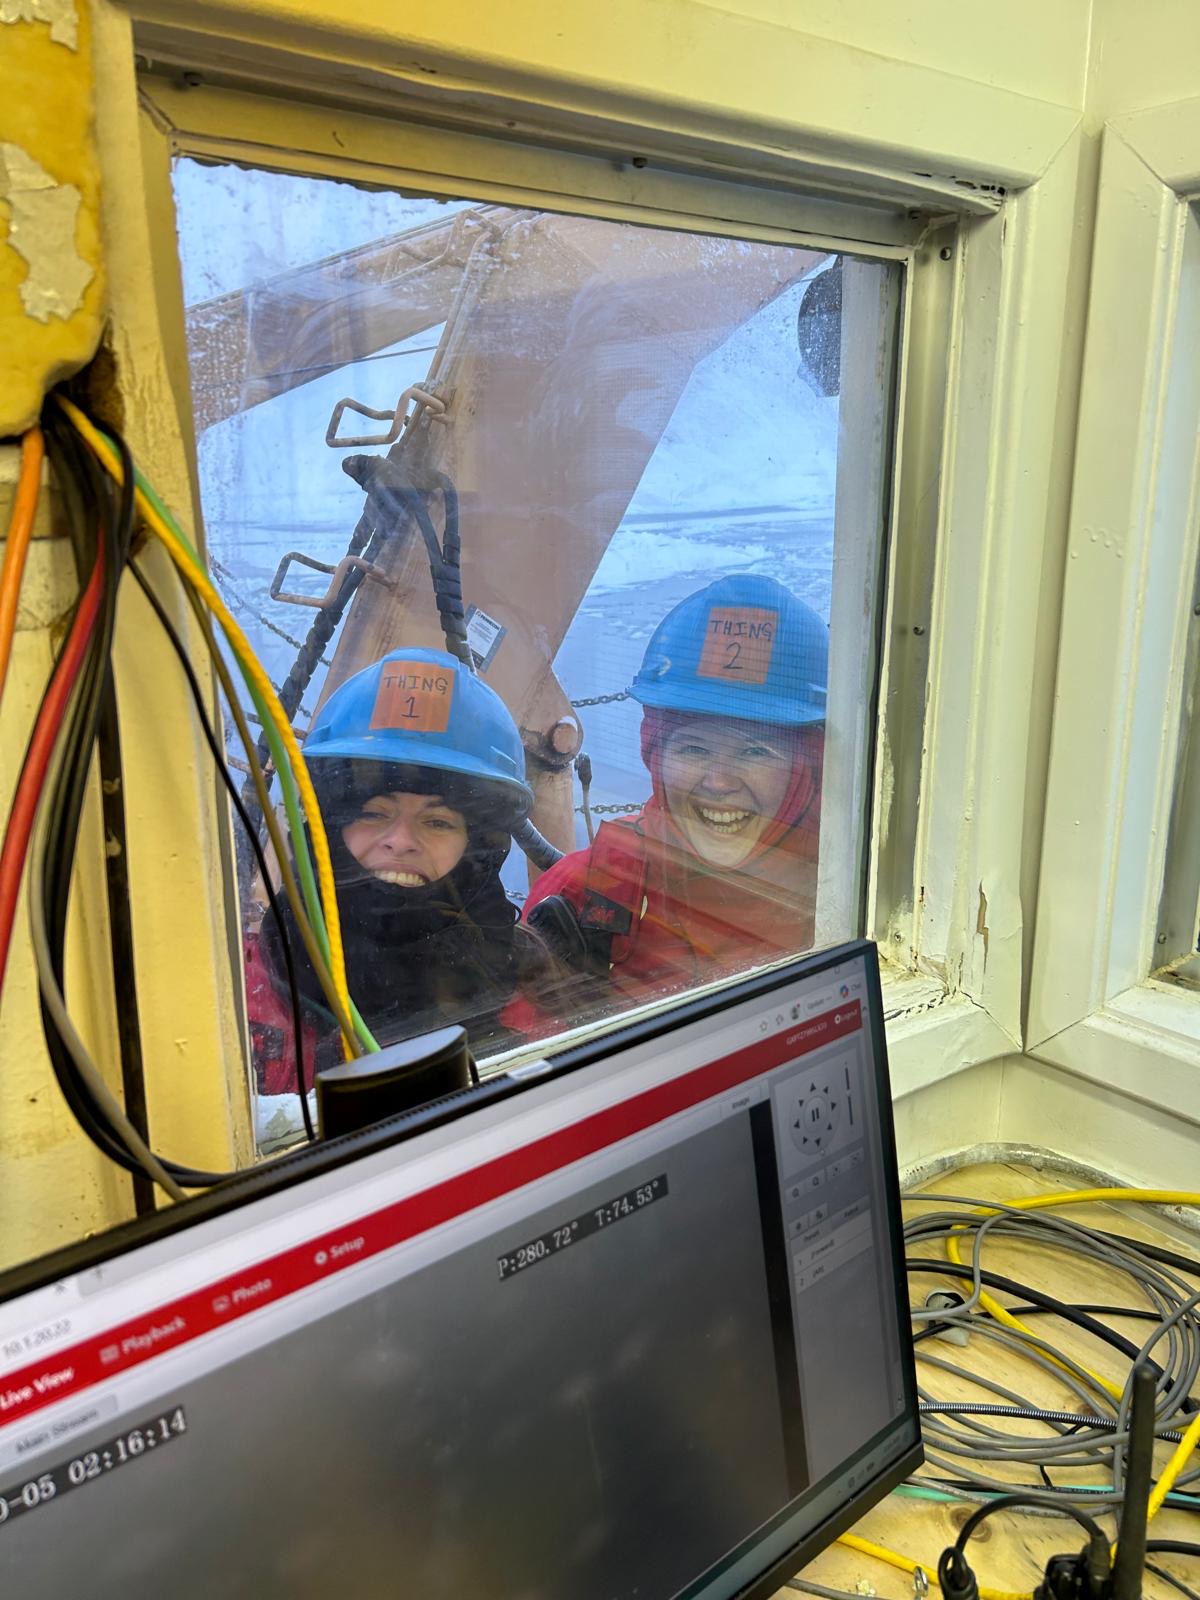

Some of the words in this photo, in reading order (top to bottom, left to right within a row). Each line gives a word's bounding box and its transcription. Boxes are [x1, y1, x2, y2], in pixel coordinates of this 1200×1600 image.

[709, 620, 773, 642] THING
[722, 641, 744, 670] 2
[383, 674, 449, 695] THING
[400, 695, 421, 719] 1
[595, 1179, 659, 1227] T:74.53°
[329, 1236, 365, 1259] Setup
[231, 1278, 272, 1303] Photo
[121, 1315, 186, 1355] Playback
[0, 1385, 34, 1411] Live
[33, 1366, 75, 1393] View
[68, 1408, 187, 1485] 02:16:14
